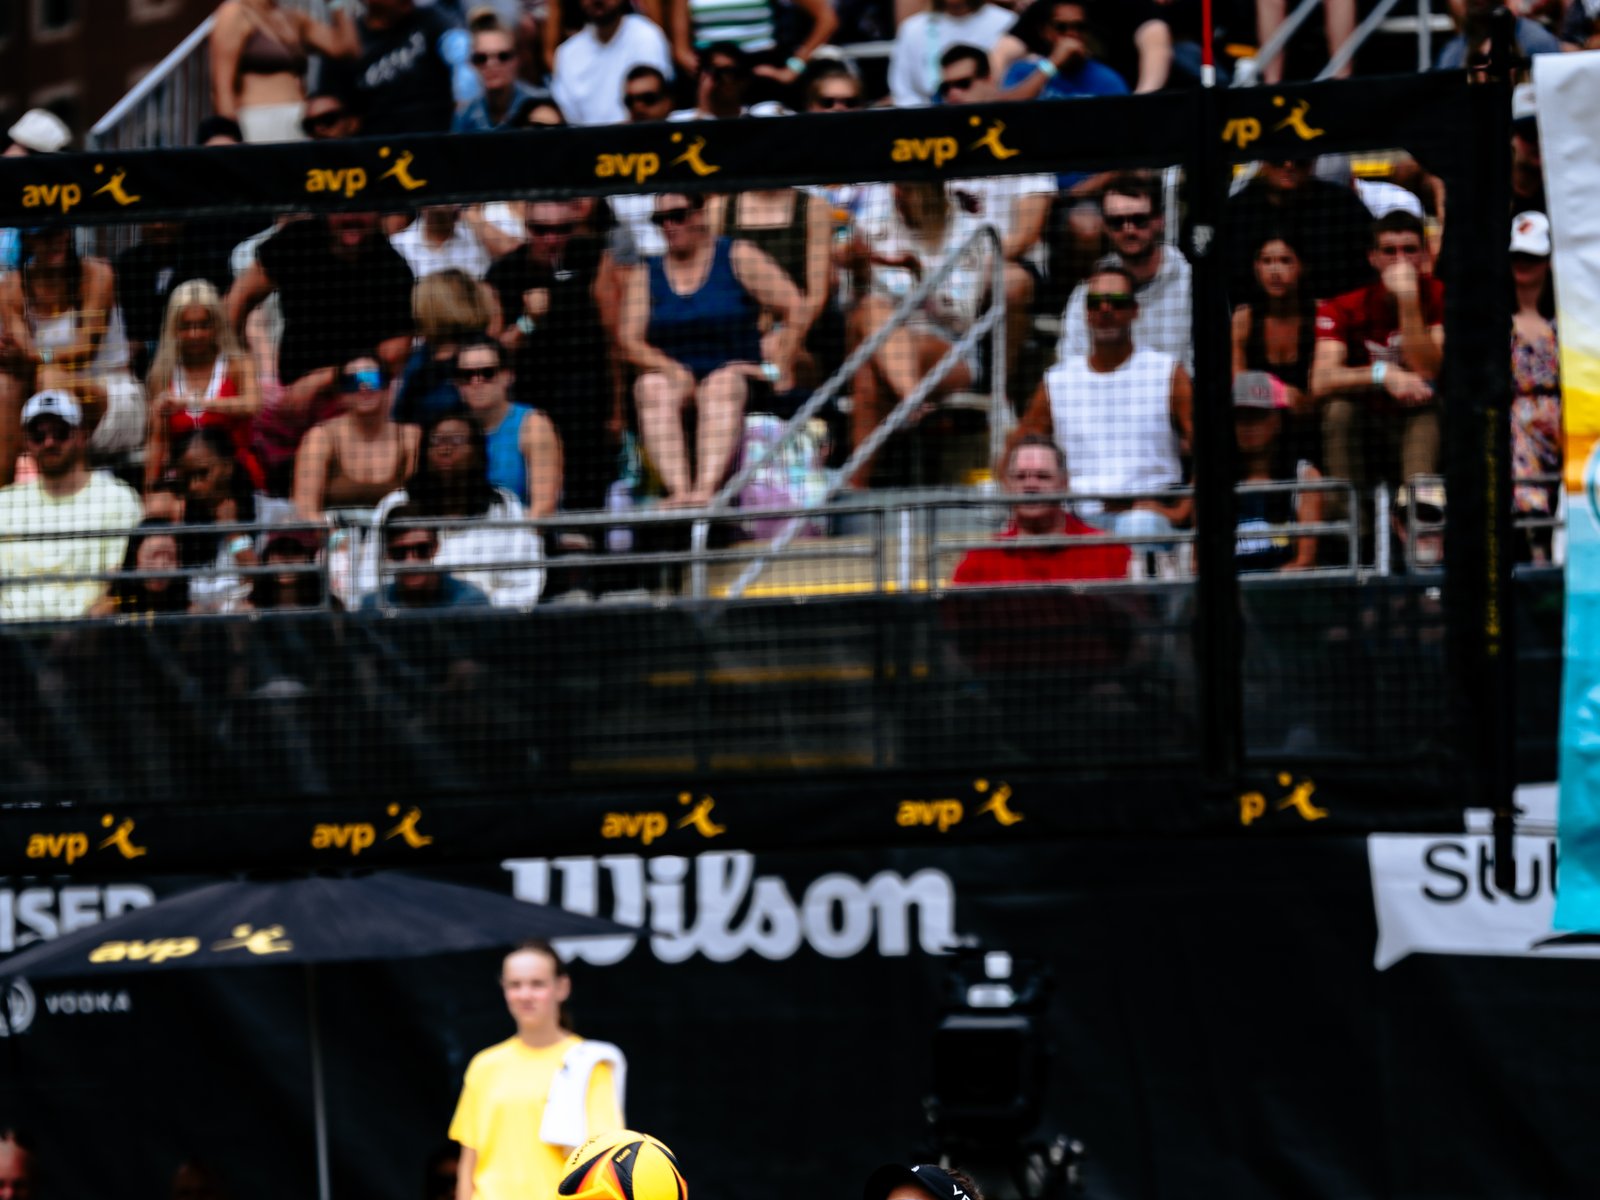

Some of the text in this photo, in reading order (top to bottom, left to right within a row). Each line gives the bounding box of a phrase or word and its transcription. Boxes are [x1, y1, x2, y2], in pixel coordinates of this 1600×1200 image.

[891, 136, 958, 166] avp
[306, 167, 367, 197] avp
[595, 152, 660, 183] avp
[22, 184, 81, 212] avp
[601, 812, 668, 845] avp
[896, 799, 963, 831] avp
[26, 833, 89, 864] avp
[311, 823, 376, 854] avp
[1422, 842, 1558, 904] Stu
[502, 850, 955, 966] Wilson
[89, 937, 199, 963] avp
